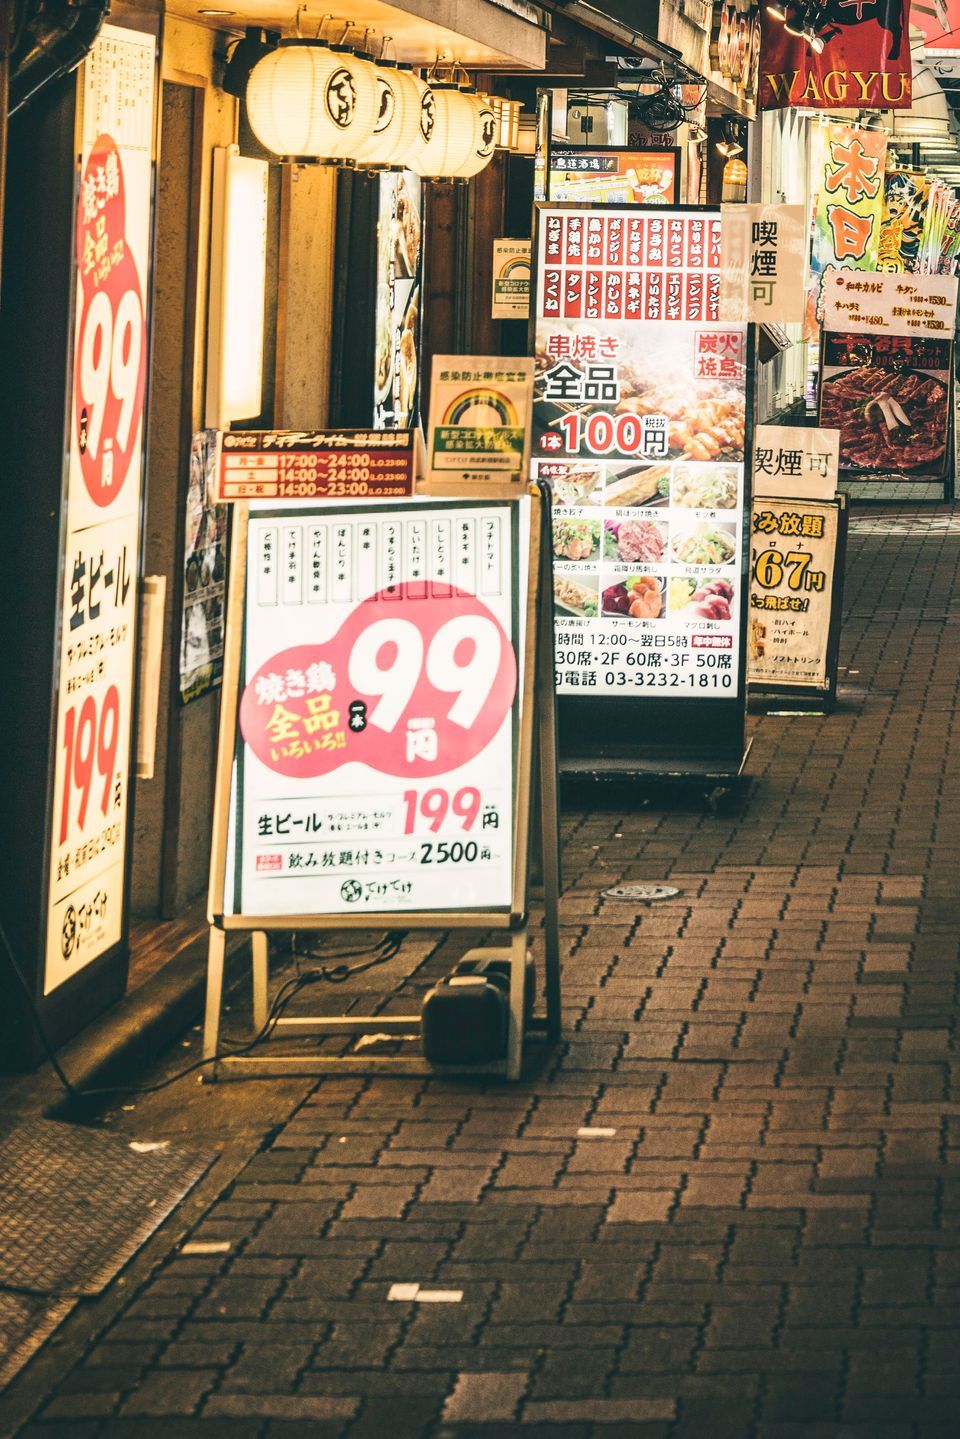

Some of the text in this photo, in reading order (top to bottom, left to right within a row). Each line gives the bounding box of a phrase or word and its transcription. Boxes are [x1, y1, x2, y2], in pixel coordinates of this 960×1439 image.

[766, 68, 911, 104] WAGYU
[824, 139, 882, 262] 本日
[548, 217, 562, 256] ねぎま
[567, 218, 582, 258] 手羽先
[649, 220, 662, 261] ささみ
[669, 221, 682, 266] なんこつ
[689, 221, 703, 266] とりはつ
[750, 220, 778, 307] 喫煙可
[545, 271, 560, 310] つくね
[567, 272, 580, 303] タン
[607, 274, 621, 314] かしら
[627, 273, 640, 313] 長ネギ
[648, 273, 660, 319] しいたけ
[668, 274, 681, 319] エリンギ
[688, 273, 702, 320] ニンニク
[845, 282, 884, 293] 和牛カルビ
[548, 333, 620, 359] 串焼き
[699, 333, 740, 355] 炭火
[79, 289, 142, 463] 99
[545, 364, 618, 401] 全品
[540, 436, 563, 450] 1本
[554, 632, 584, 647] 時間
[254, 660, 338, 706] 焼き鶏
[347, 614, 502, 734] 99
[605, 671, 733, 688] 03-3232-1810
[264, 694, 341, 743] 全品
[257, 812, 322, 837] 生ビール
